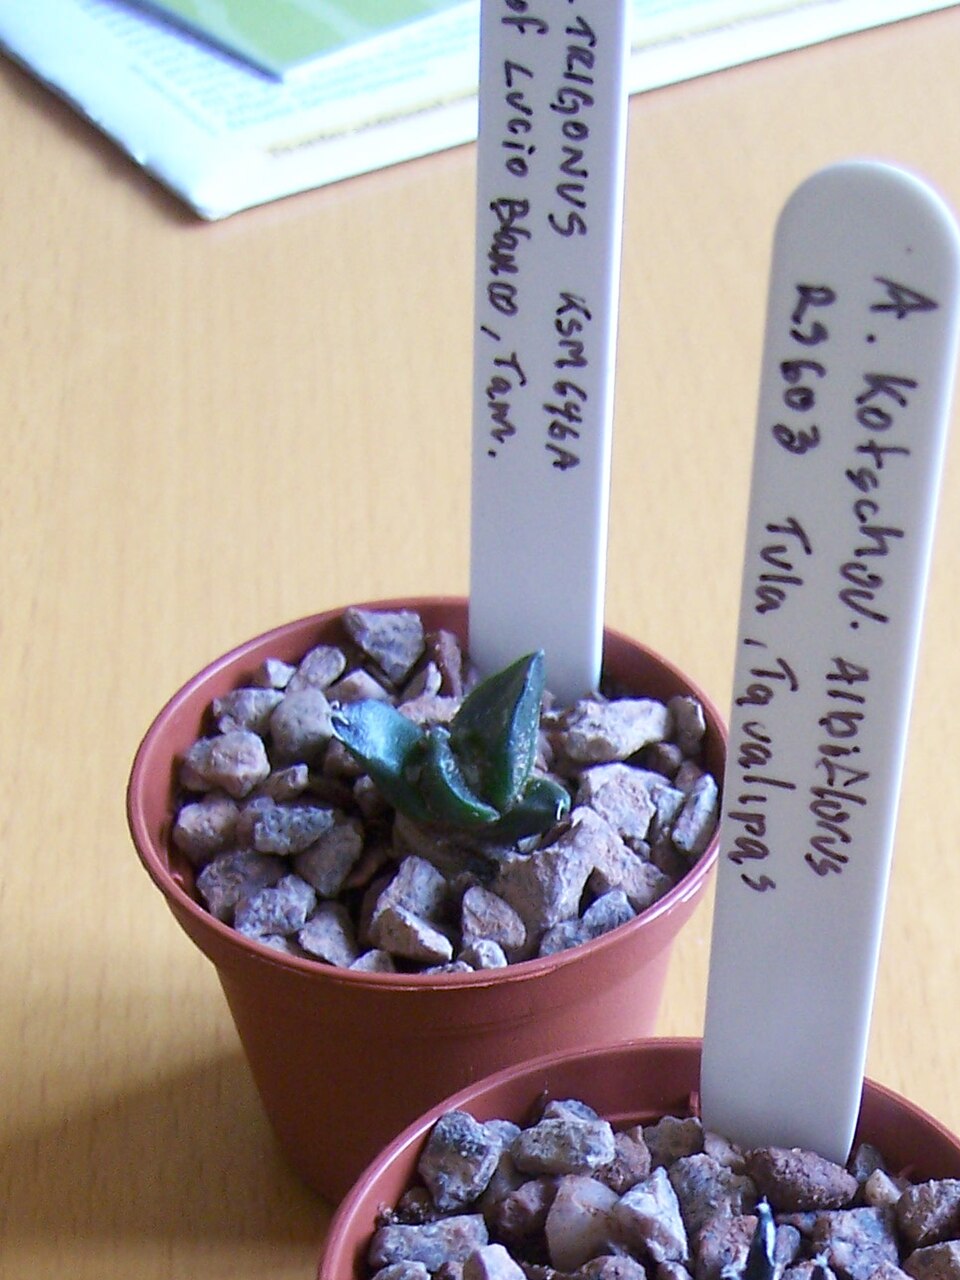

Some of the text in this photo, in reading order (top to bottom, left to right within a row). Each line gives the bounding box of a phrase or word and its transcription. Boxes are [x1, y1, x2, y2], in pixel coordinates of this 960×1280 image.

[501, 59, 537, 178] Lucio
[547, 15, 598, 238] TRIGONUS
[865, 275, 940, 345] A.
